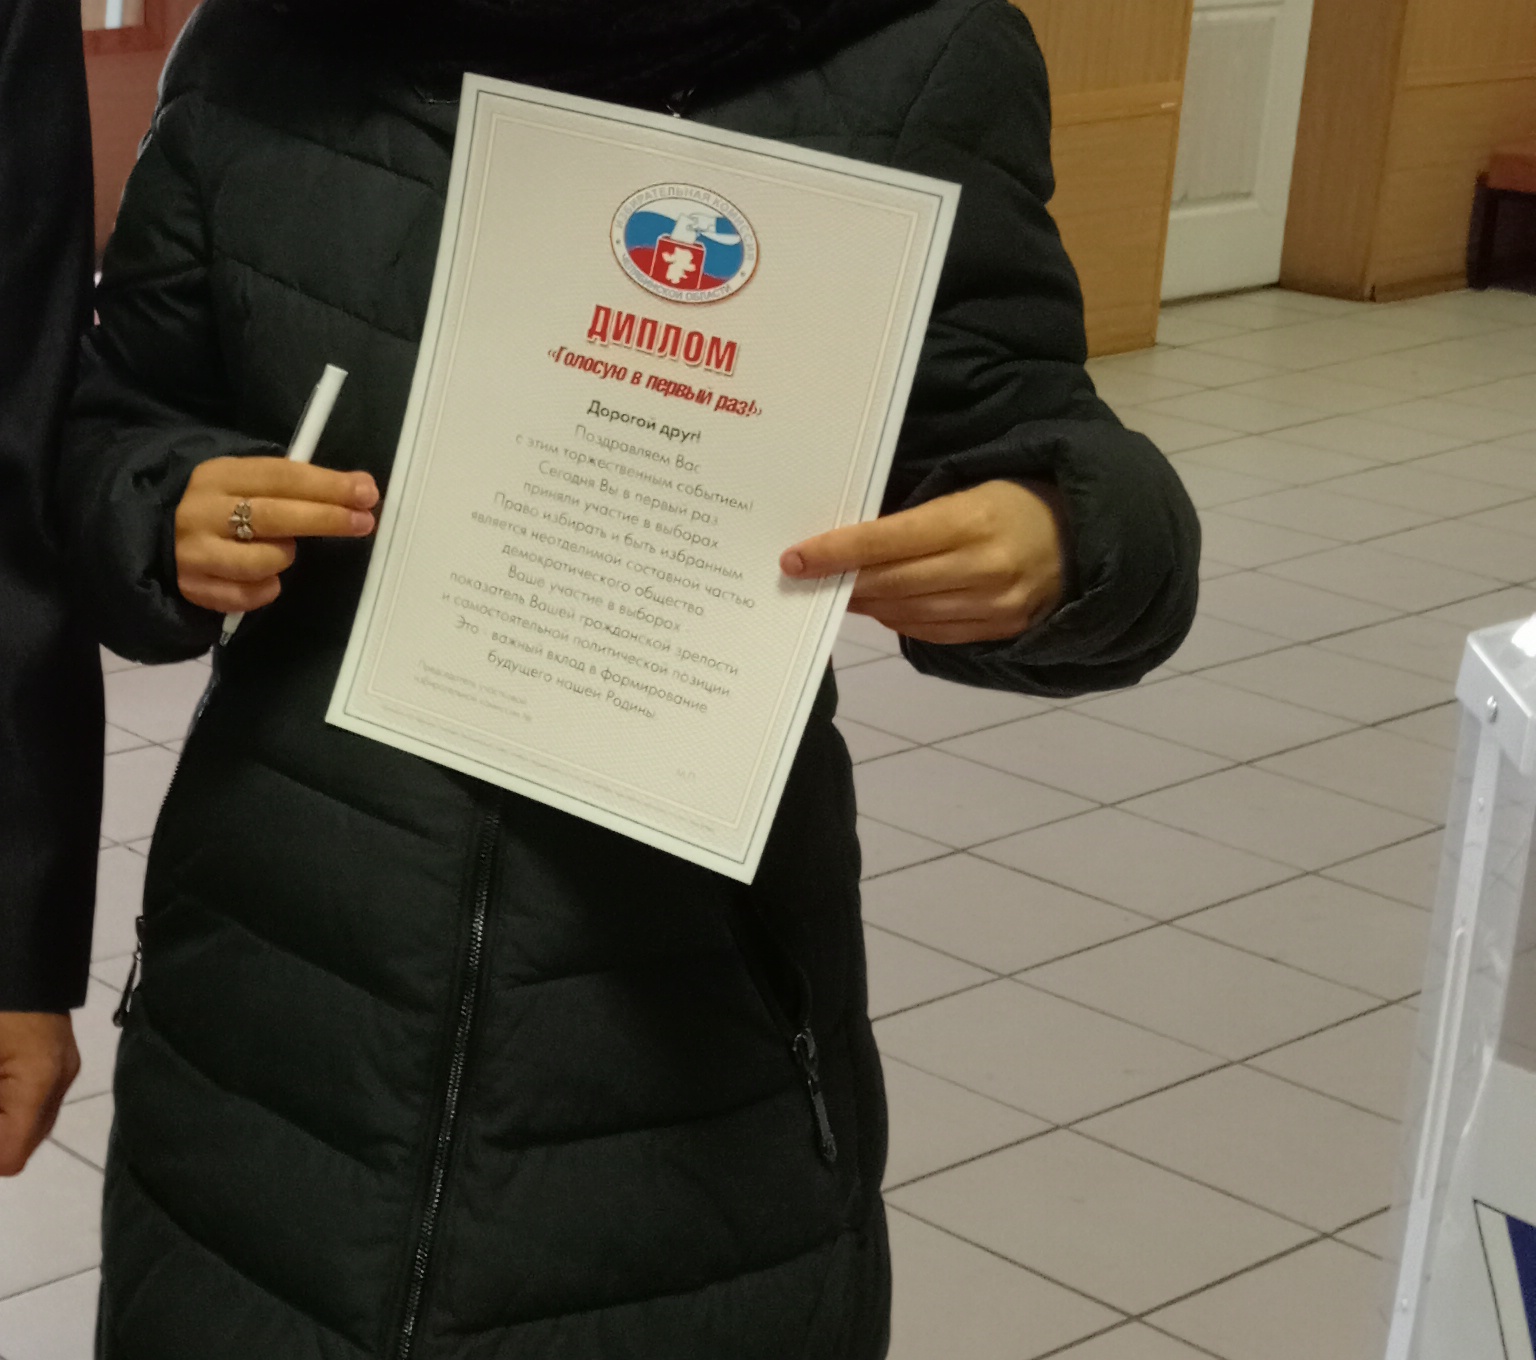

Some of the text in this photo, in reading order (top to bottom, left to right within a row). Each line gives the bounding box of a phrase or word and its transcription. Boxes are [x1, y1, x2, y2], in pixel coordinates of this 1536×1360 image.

[616, 186, 755, 262] ИЗБИРАТЕЛЬНАЯ КОМИССИЯ
[685, 284, 733, 302] ОБЛАСТИ
[587, 304, 739, 375] ДИПЛОМ
[548, 346, 762, 417] «Голосую в первый раз!»
[575, 424, 702, 474] Поздравляем Вас
[587, 400, 701, 443] Дорогой друг!
[516, 434, 753, 512] с этим торжественным событием!
[539, 460, 595, 487] Сегодня
[600, 478, 618, 495] Вы
[623, 489, 630, 499] в
[636, 492, 688, 516] первый
[495, 491, 539, 517] Право
[543, 512, 606, 538] избирать
[624, 532, 656, 554] быть
[661, 548, 743, 580] избранным
[524, 482, 718, 548] приняли участие в выборах
[471, 511, 755, 609] является неотделимой составной частью
[502, 544, 631, 592] демократического
[508, 564, 545, 587] Ваше
[550, 584, 603, 606] участие
[608, 601, 615, 611] в
[450, 571, 739, 675] показатель Вашей гражданской зрелости
[454, 595, 569, 641] самостоятельной
[573, 637, 668, 674] политической
[673, 670, 730, 697] позиции
[455, 615, 708, 713] Это важный вклад в формирование
[487, 650, 552, 683] будущего
[556, 676, 601, 699] нашей
